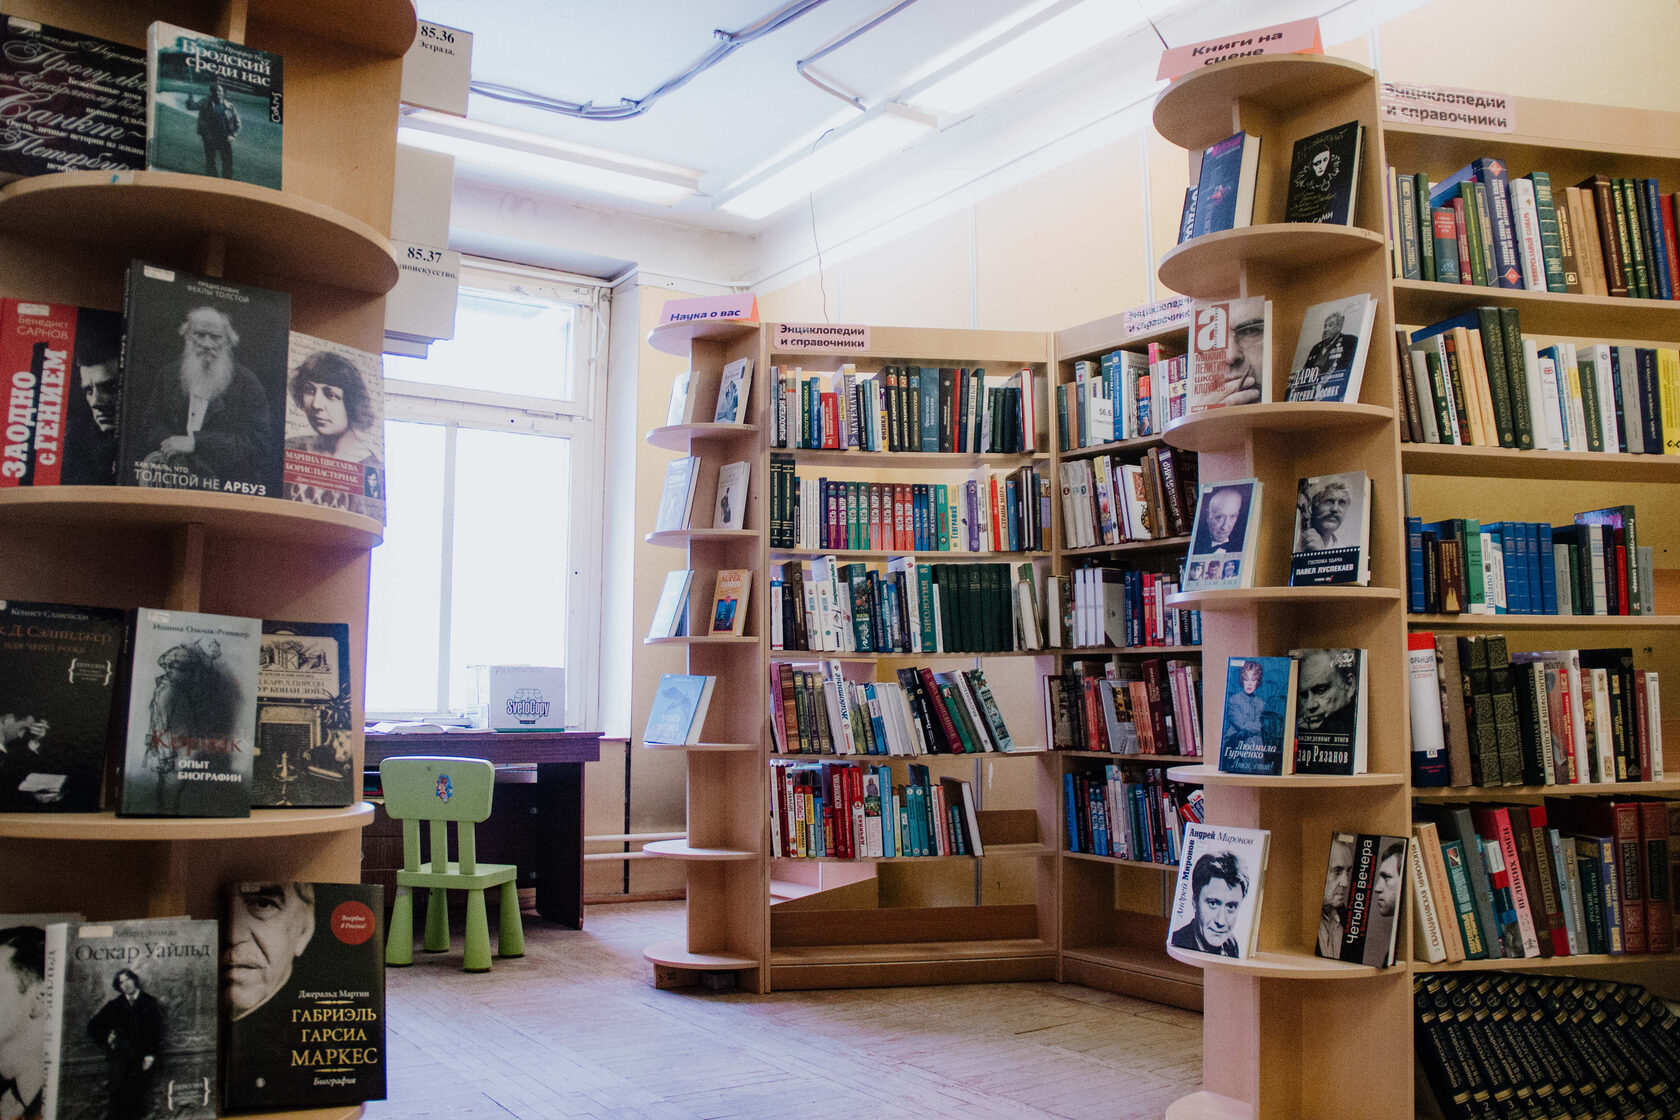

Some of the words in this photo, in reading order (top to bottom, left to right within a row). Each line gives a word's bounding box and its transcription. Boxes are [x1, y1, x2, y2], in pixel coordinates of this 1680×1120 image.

[421, 25, 455, 44] 85.36
[1191, 38, 1254, 58] Книги
[1258, 30, 1283, 44] на
[418, 39, 455, 56] Эстрада.
[1203, 47, 1265, 67] сцене
[182, 40, 270, 75] Бродский
[186, 56, 238, 82] среди
[242, 71, 270, 87] нас
[1384, 83, 1506, 110] Энциклопедии
[1401, 106, 1507, 128] справочники
[407, 247, 442, 264] 85.37
[215, 289, 250, 304] ТОЛСТОЙ
[18, 315, 69, 329] Бенедикт
[670, 312, 707, 321] Наука
[720, 309, 741, 317] вас
[17, 326, 68, 339] САРНОВ
[780, 324, 865, 336] Энциклопедии
[790, 338, 865, 348] справочники
[1292, 366, 1319, 388] ДАРЮ,
[34, 349, 67, 446] ГЕНИЕМ
[847, 375, 858, 434] МАТЕМАТИКА
[2, 372, 36, 478] ЗАОДНО
[778, 400, 787, 440] ЭНЦИКЛОПЕДИЯ
[879, 415, 887, 440] ФИЗИКА
[1440, 409, 1452, 435] English
[174, 465, 189, 474] ЧТО
[285, 451, 320, 464] МАРИНА
[320, 458, 358, 472] ЦВЕТАЕВА
[1163, 461, 1174, 480] МИР
[134, 468, 198, 488] ТОЛСТОЙ
[203, 478, 220, 491] НЕ
[224, 480, 266, 496] АРБУЗ
[285, 463, 313, 475] БОРИС
[313, 468, 358, 484] ПАСТЕРНАК
[1295, 567, 1317, 576] ПАВЕЛ
[1317, 563, 1354, 575] ЛУСПЕКАЕВ
[1485, 574, 1494, 608] Italiano
[921, 580, 931, 632] БИОЛОГИЯ
[1410, 656, 1434, 665] ФРАНЦИЯ
[270, 686, 300, 694] КОНАН
[834, 672, 848, 720] Животные
[1528, 668, 1539, 721] МИФОЛОГИЯ
[1538, 669, 1547, 717] МИФОЛОГИЯ
[506, 699, 550, 717] SvetoCopy
[1224, 746, 1264, 760] Гурченко
[1236, 740, 1277, 752] Людмила
[1312, 746, 1349, 765] Рязанов
[178, 759, 209, 770] ОПЫТ
[177, 771, 242, 783] БИОГРАФИИ
[1190, 828, 1216, 840] Андрей
[1216, 832, 1254, 846] Миронов
[1181, 840, 1195, 881] Миронов
[1346, 891, 1365, 944] Четыре
[1357, 839, 1373, 890] вечера
[1507, 860, 1527, 909] ВЕЛИКИХ
[1176, 882, 1188, 919] Андрей
[1420, 889, 1439, 946] СКАНДИНАВСКАЯ
[75, 944, 139, 963] Оскар
[145, 943, 211, 960] Уайльд
[299, 990, 337, 1000] Джеральд
[339, 990, 370, 999] Мартин
[292, 1008, 377, 1023] ГАБРИЭЛЬ
[301, 1028, 367, 1043] ГАРСИА
[291, 1048, 378, 1067] МАРКЕС
[313, 1075, 357, 1087] Биография
[1483, 1101, 1491, 1111] 2
[1507, 1100, 1515, 1110] 3
[1527, 1098, 1535, 1108] 4
